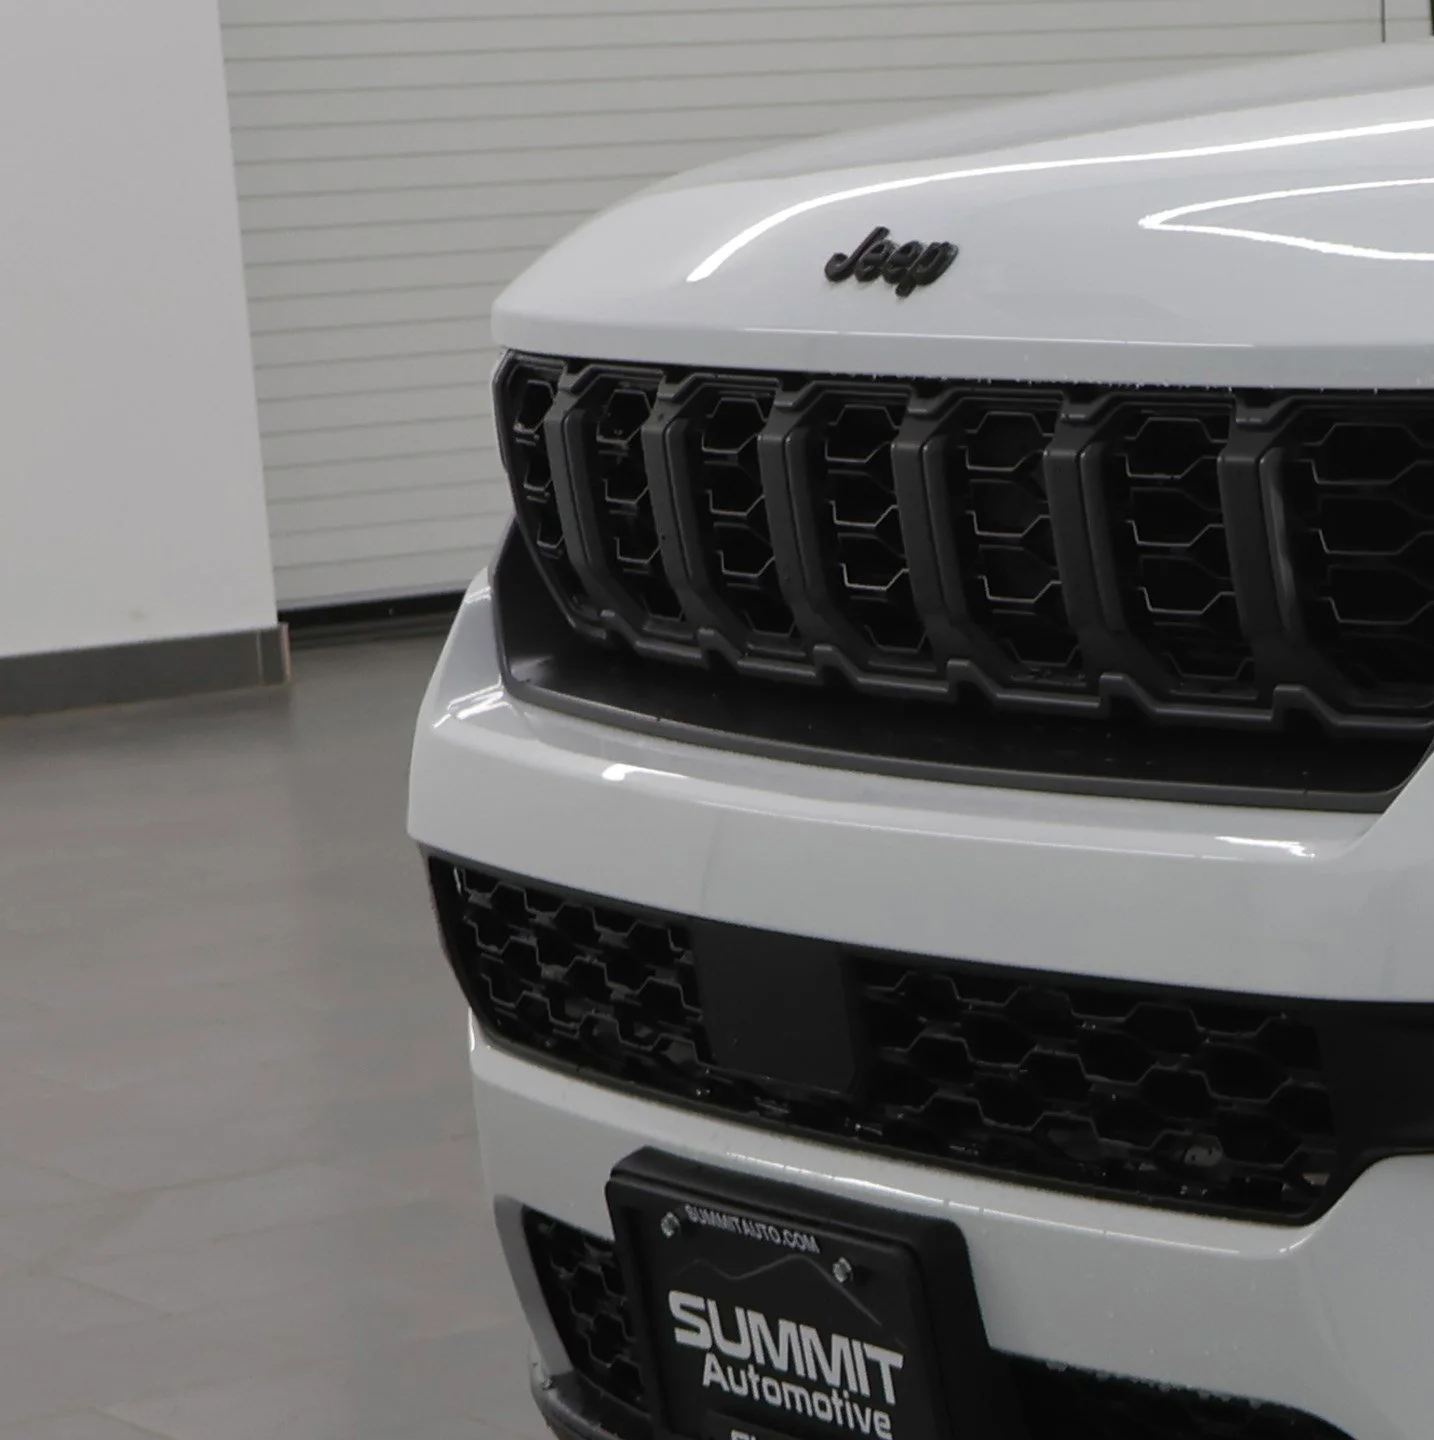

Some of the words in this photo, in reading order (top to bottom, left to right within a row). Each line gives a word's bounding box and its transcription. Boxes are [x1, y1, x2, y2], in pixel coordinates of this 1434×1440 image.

[824, 226, 959, 298] Jeep
[684, 1204, 820, 1255] SUMMITAUTO.COM
[668, 1289, 904, 1405] SUMMIT
